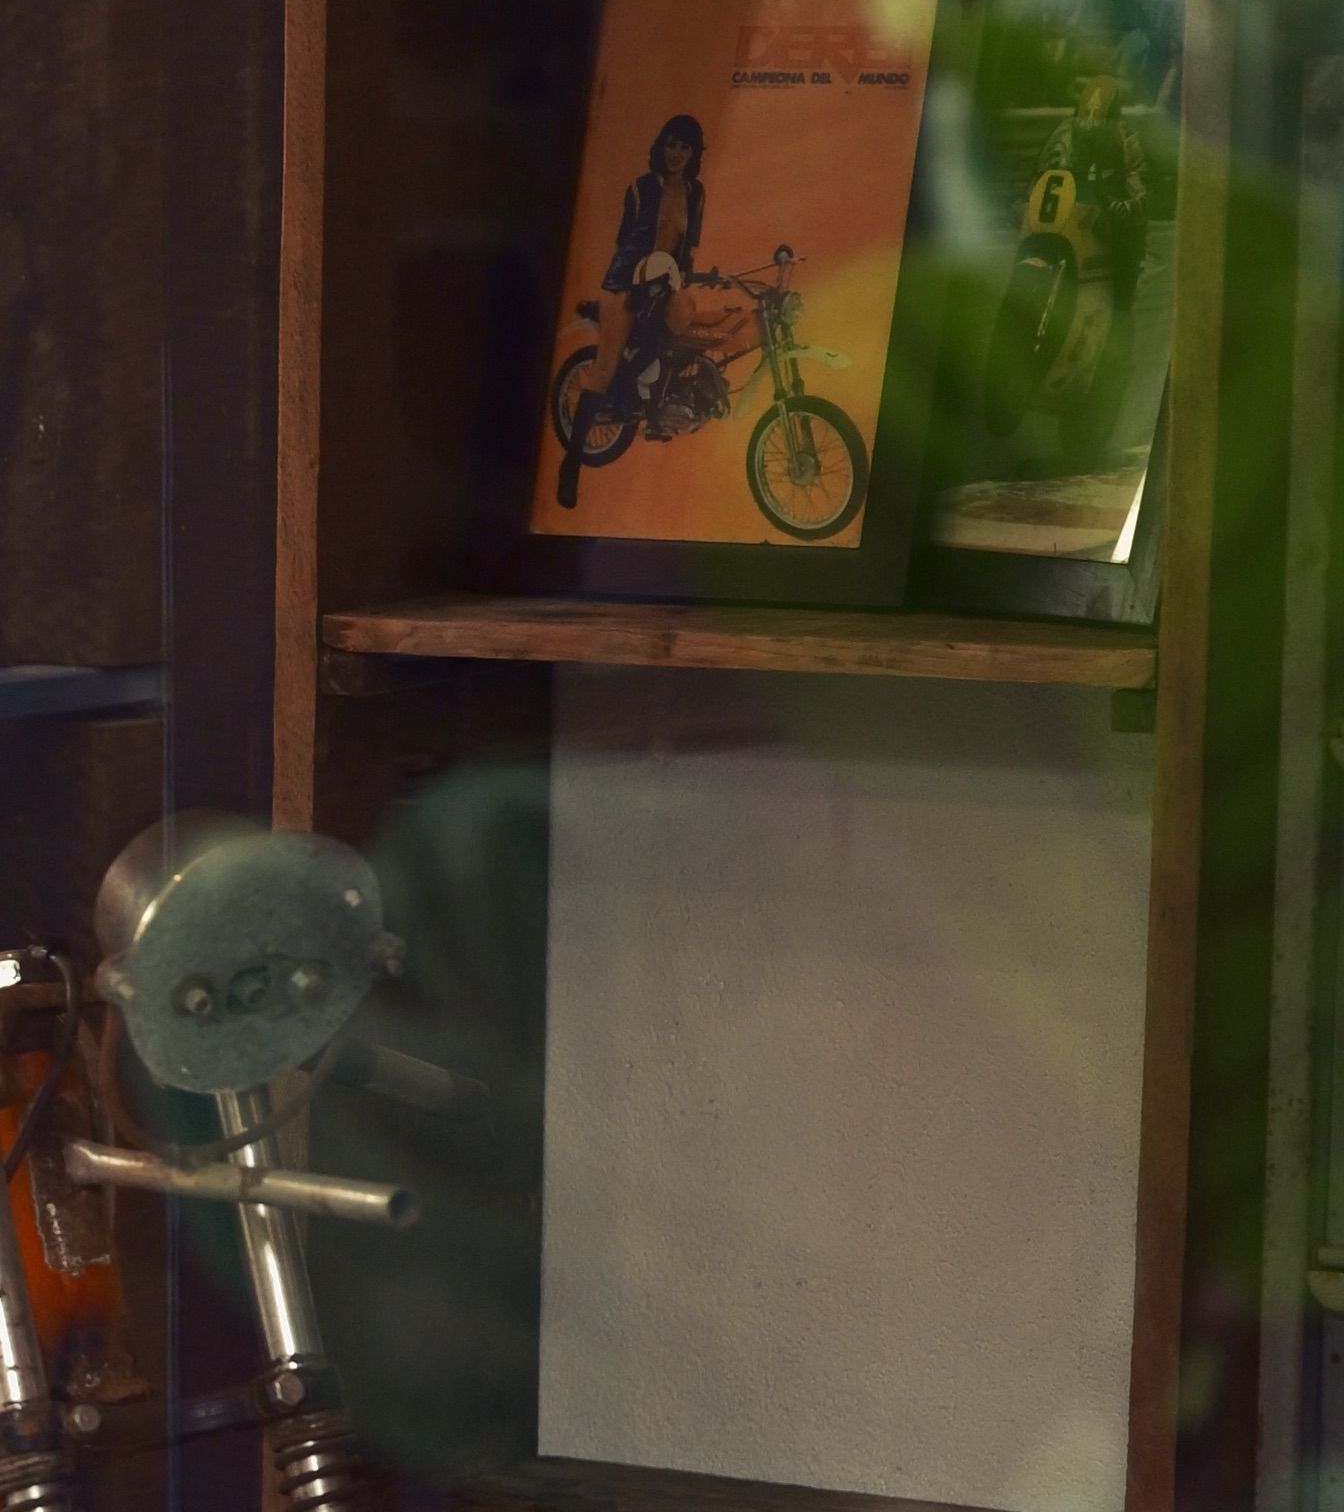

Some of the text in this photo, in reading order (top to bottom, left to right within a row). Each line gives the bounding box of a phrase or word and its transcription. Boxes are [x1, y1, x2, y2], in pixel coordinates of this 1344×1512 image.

[731, 71, 911, 86] CAMPEONA DEL MUNDO
[1038, 175, 1065, 223] 6
